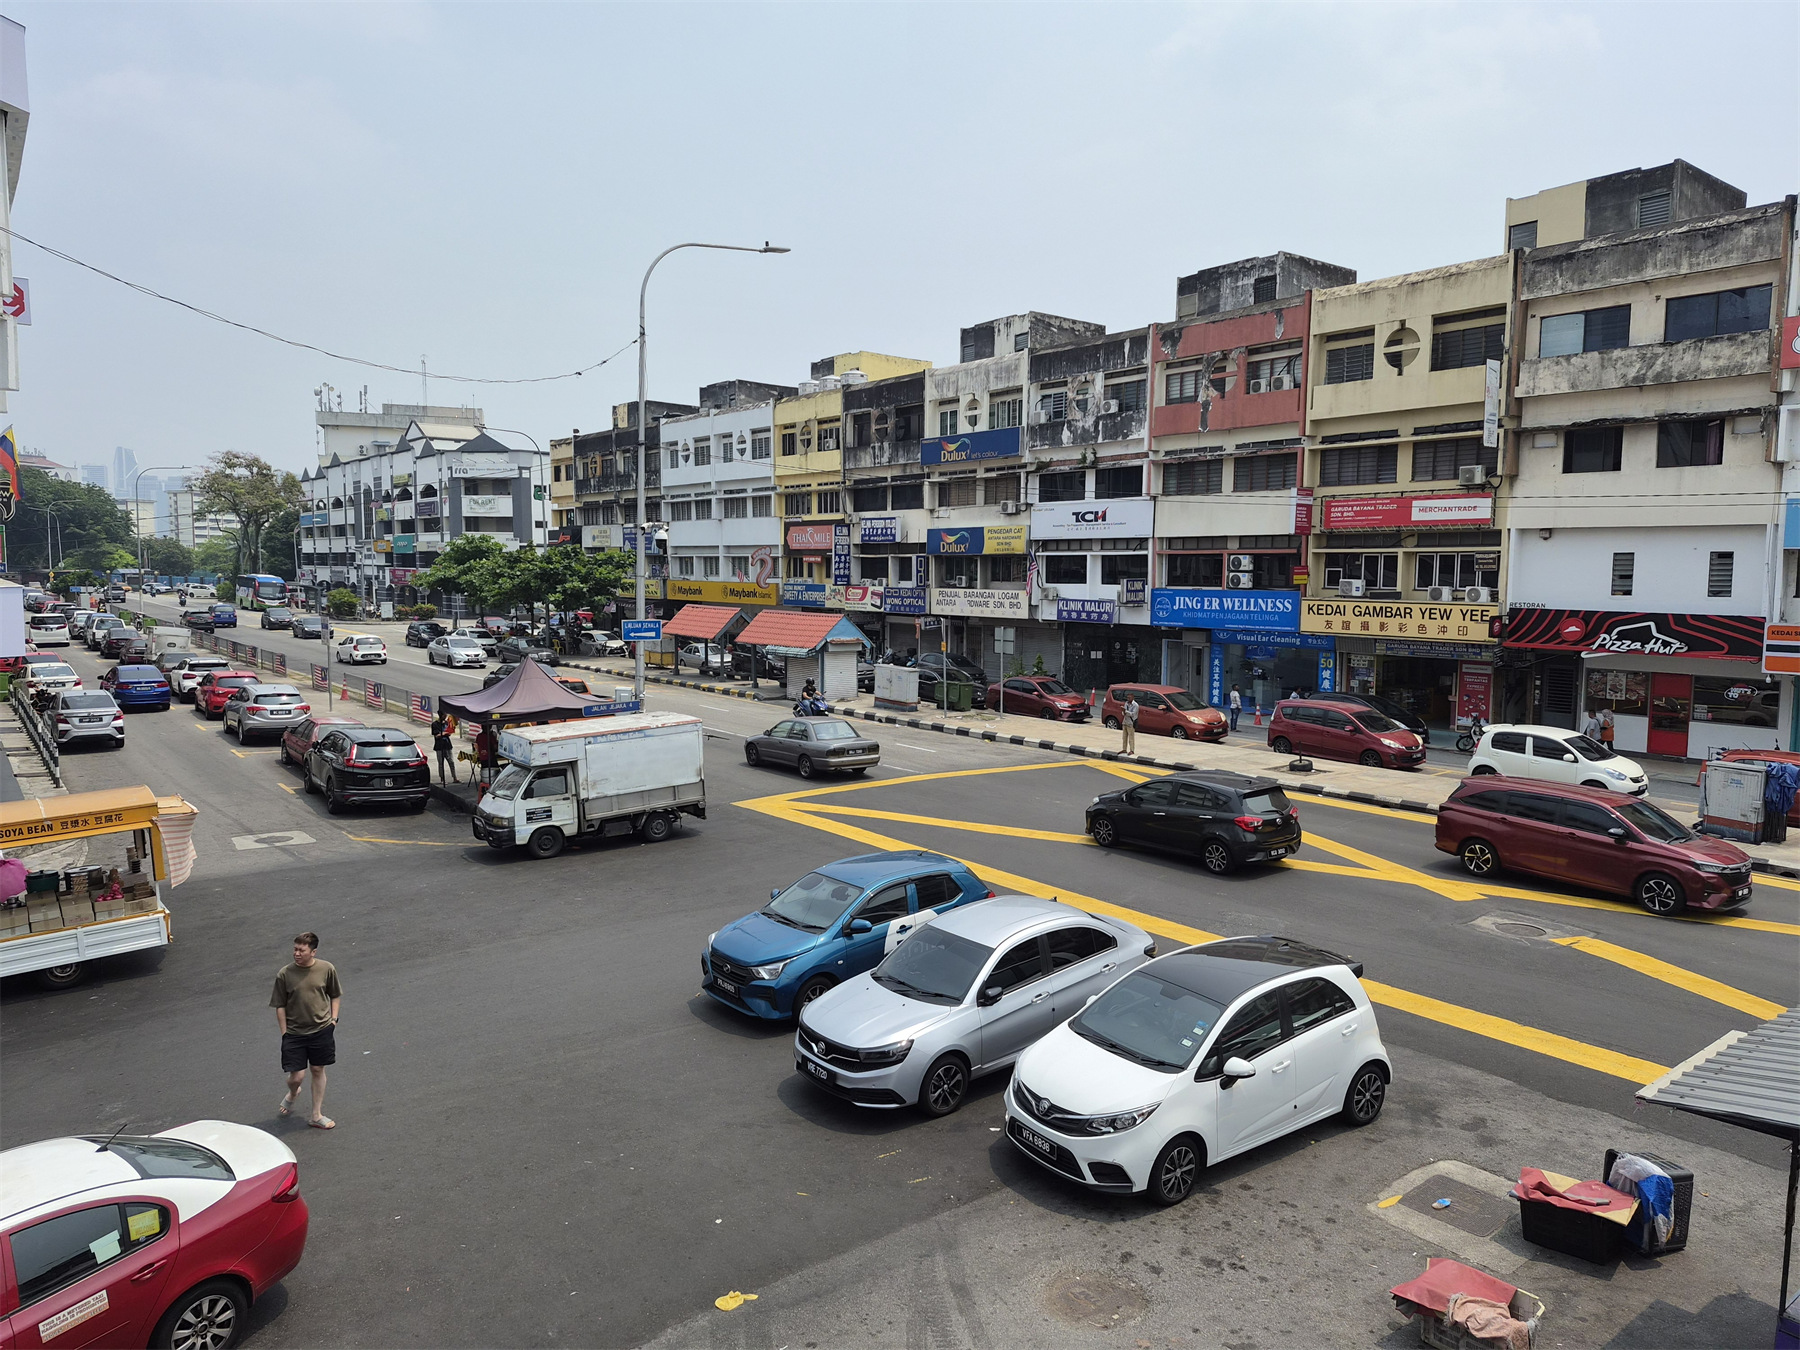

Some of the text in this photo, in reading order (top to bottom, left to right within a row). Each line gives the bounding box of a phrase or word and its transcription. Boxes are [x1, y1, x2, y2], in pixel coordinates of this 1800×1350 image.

[941, 451, 967, 462] Dulux
[1418, 505, 1478, 513] MERCHANTRADE
[792, 534, 807, 543] THAI
[940, 541, 965, 553] Dulux
[1127, 580, 1144, 590] KLINIK
[677, 585, 703, 597] Maybank
[729, 587, 758, 599] Maybank
[938, 590, 1020, 600] PENJUAL BARANGAN LOGAM
[885, 597, 925, 606] WONG OPTICAL
[992, 601, 1006, 609] SDN.
[1008, 601, 1023, 610] BHD.
[1058, 600, 1113, 613] KLINIK MALURI
[1173, 596, 1293, 613] JING ER WELLNESS
[1509, 601, 1546, 609] RESTORAN
[1182, 611, 1279, 621] KHIDMAT PENJAGAAN TELINGA
[1307, 603, 1490, 622] KEDAI GAMBAR YEW YEE
[642, 621, 659, 629] SEHALA
[1771, 629, 1793, 637] KEDAI
[1236, 633, 1300, 645] Visual Ear Cleaning
[1589, 633, 1685, 655] Pizza Hut
[1320, 659, 1333, 669] 50
[94, 813, 124, 825] 豆腐花
[0, 823, 54, 839] SOYA BEAN
[41, 1319, 55, 1329] THIS
[67, 1300, 91, 1316] METERED
[92, 1293, 104, 1302] TAXI
